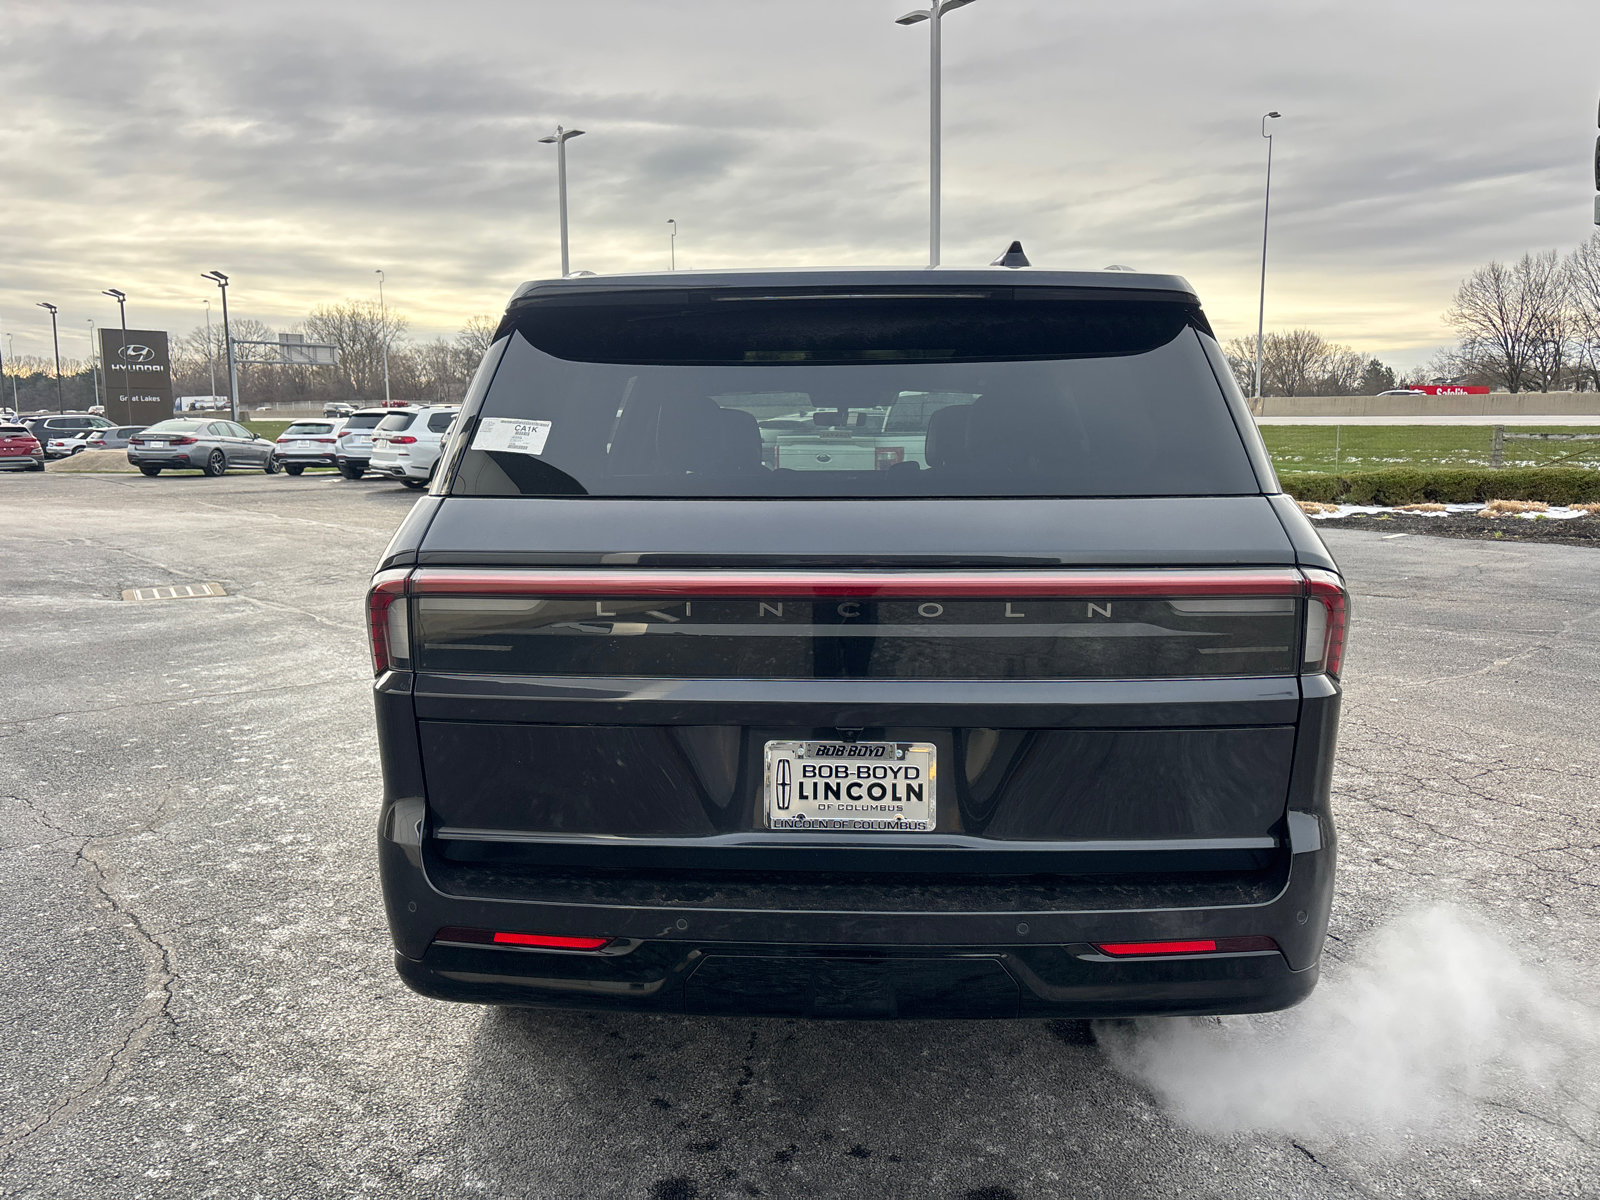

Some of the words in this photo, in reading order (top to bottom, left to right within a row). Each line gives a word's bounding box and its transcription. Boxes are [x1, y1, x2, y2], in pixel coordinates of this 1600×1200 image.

[111, 364, 164, 372] HYUNDAI
[514, 425, 539, 433] CA1K
[595, 601, 1113, 618] LINCOLN
[802, 765, 920, 780] BOB-BOYD
[798, 782, 923, 802] LINCOLN
[837, 804, 904, 812] COLUMBUS
[773, 820, 829, 829] LINCOLN
[833, 821, 849, 829] OF
[853, 821, 926, 830] COLUMBUS
